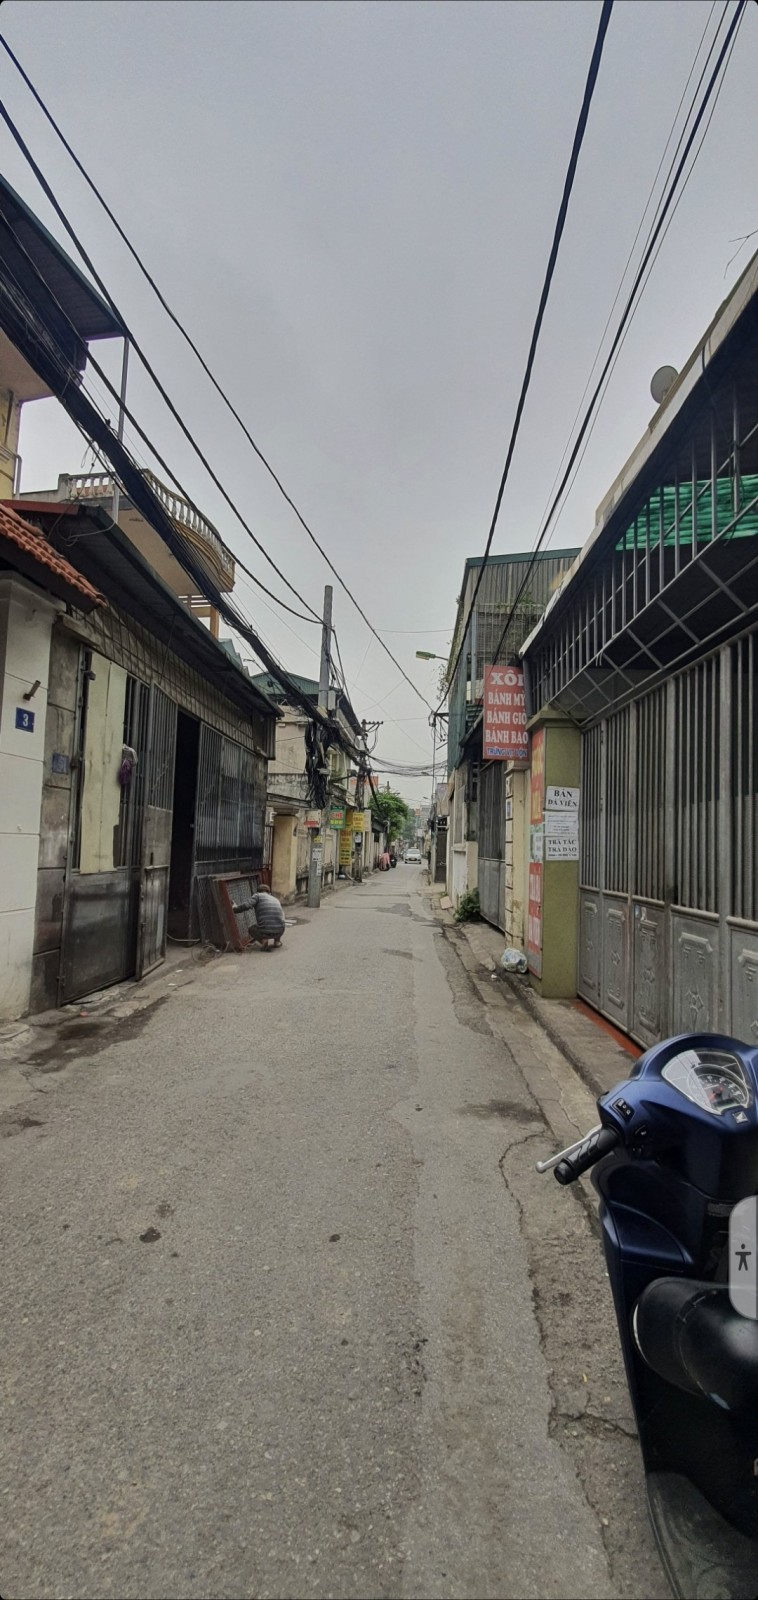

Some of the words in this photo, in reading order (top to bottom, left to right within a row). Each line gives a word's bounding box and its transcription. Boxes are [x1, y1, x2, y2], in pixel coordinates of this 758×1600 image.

[491, 670, 525, 687] XÔI
[488, 689, 512, 705] BÁNH
[22, 713, 29, 727] 3
[487, 708, 511, 724] BÁNH
[486, 727, 509, 743] BÁNH
[511, 732, 528, 744] BAO
